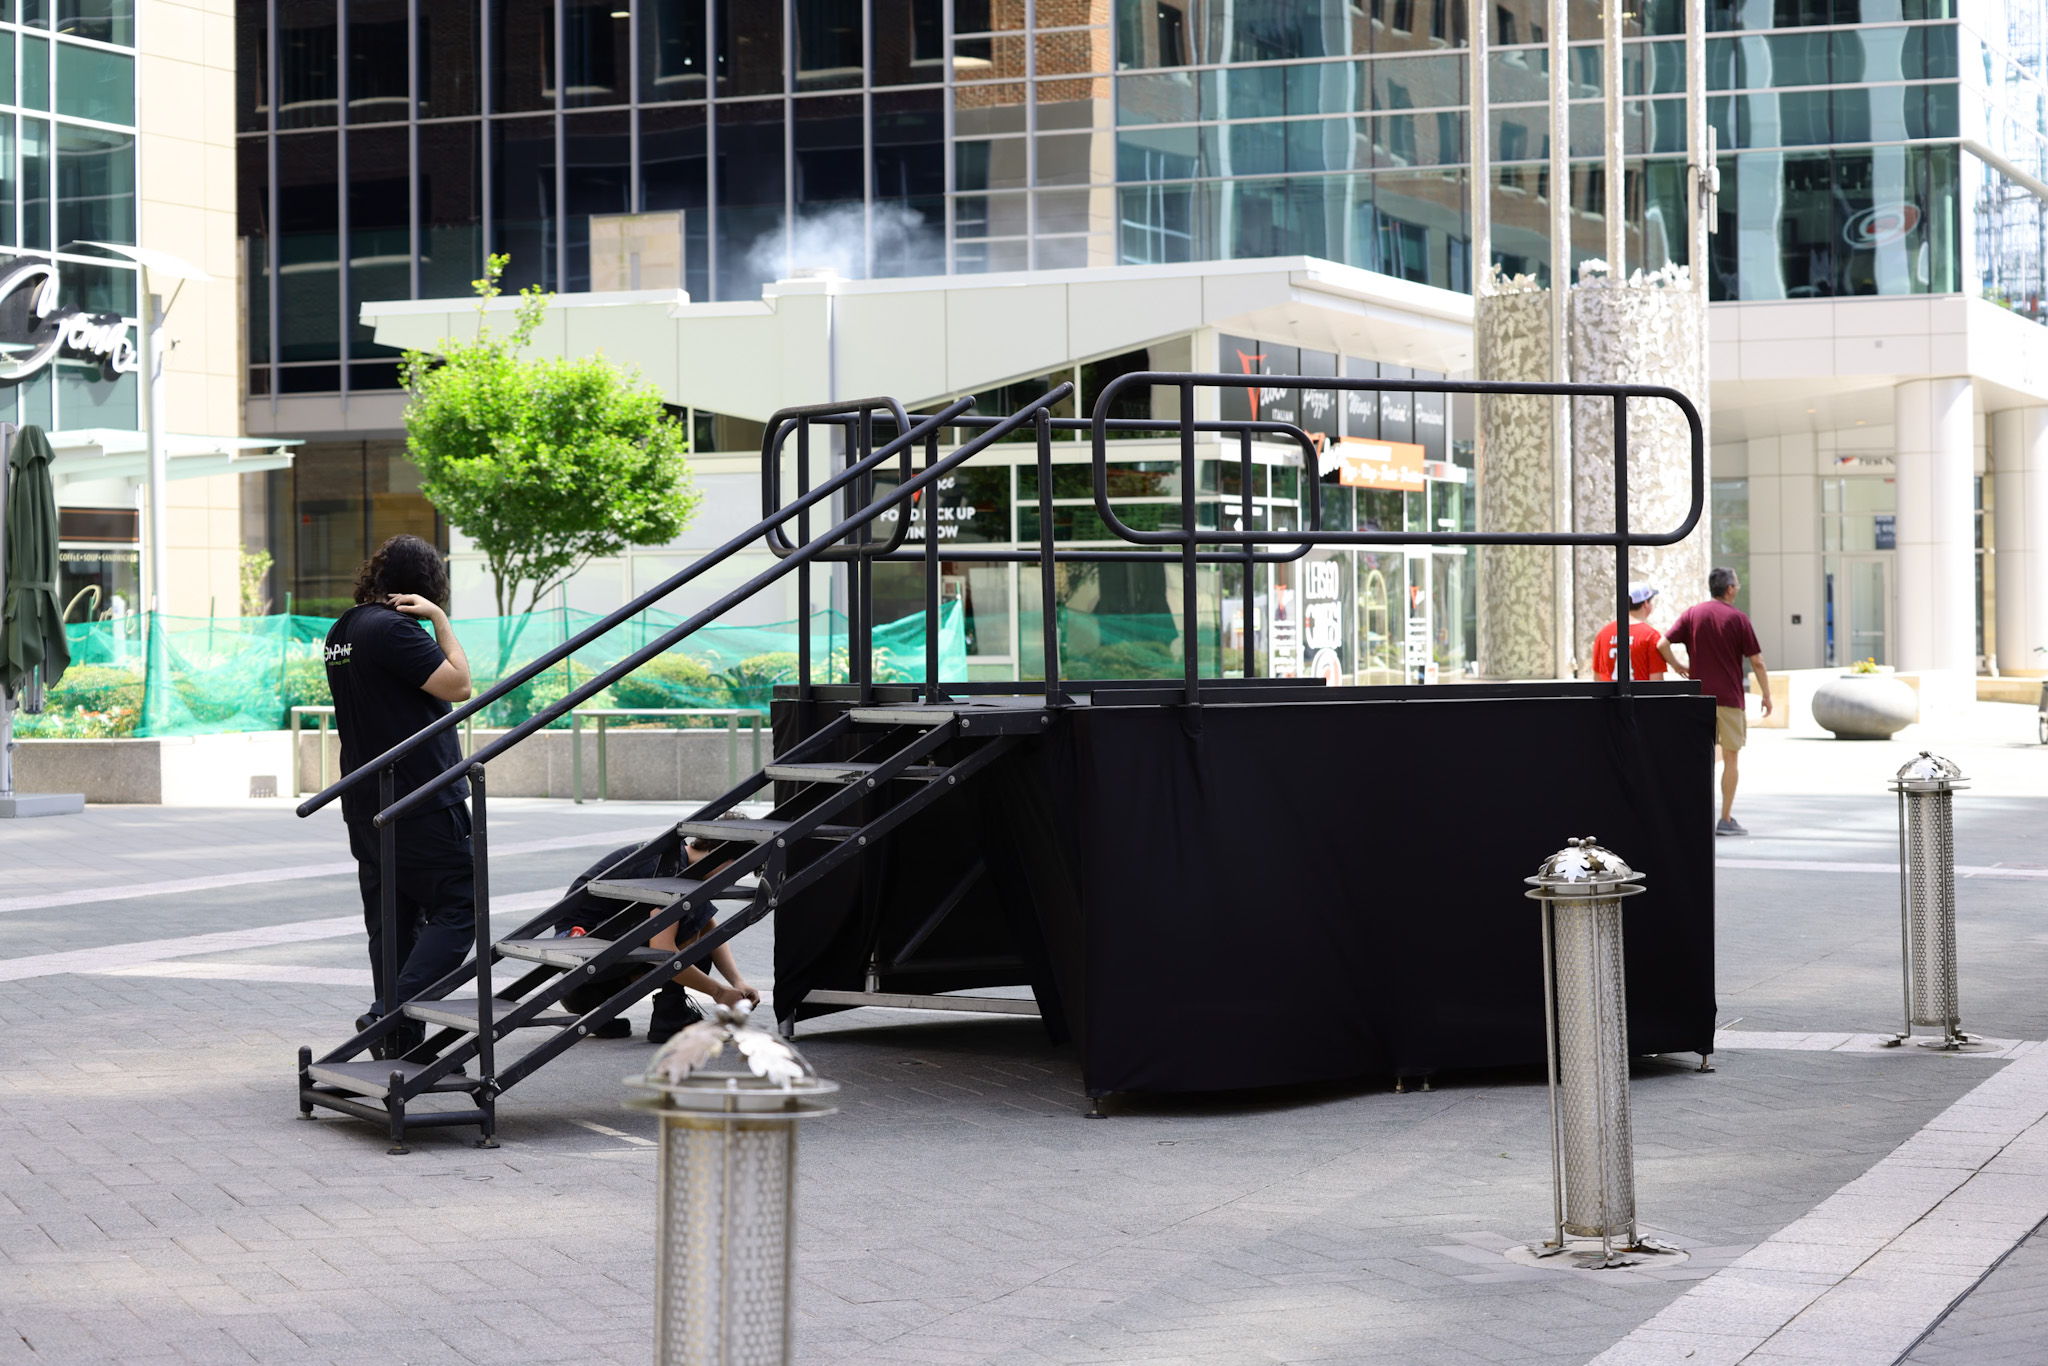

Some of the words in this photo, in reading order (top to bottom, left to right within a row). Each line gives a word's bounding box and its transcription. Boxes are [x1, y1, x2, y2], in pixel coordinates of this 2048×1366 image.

[880, 508, 920, 522] FOD
[956, 506, 977, 520] UP
[902, 525, 959, 540] INOW
